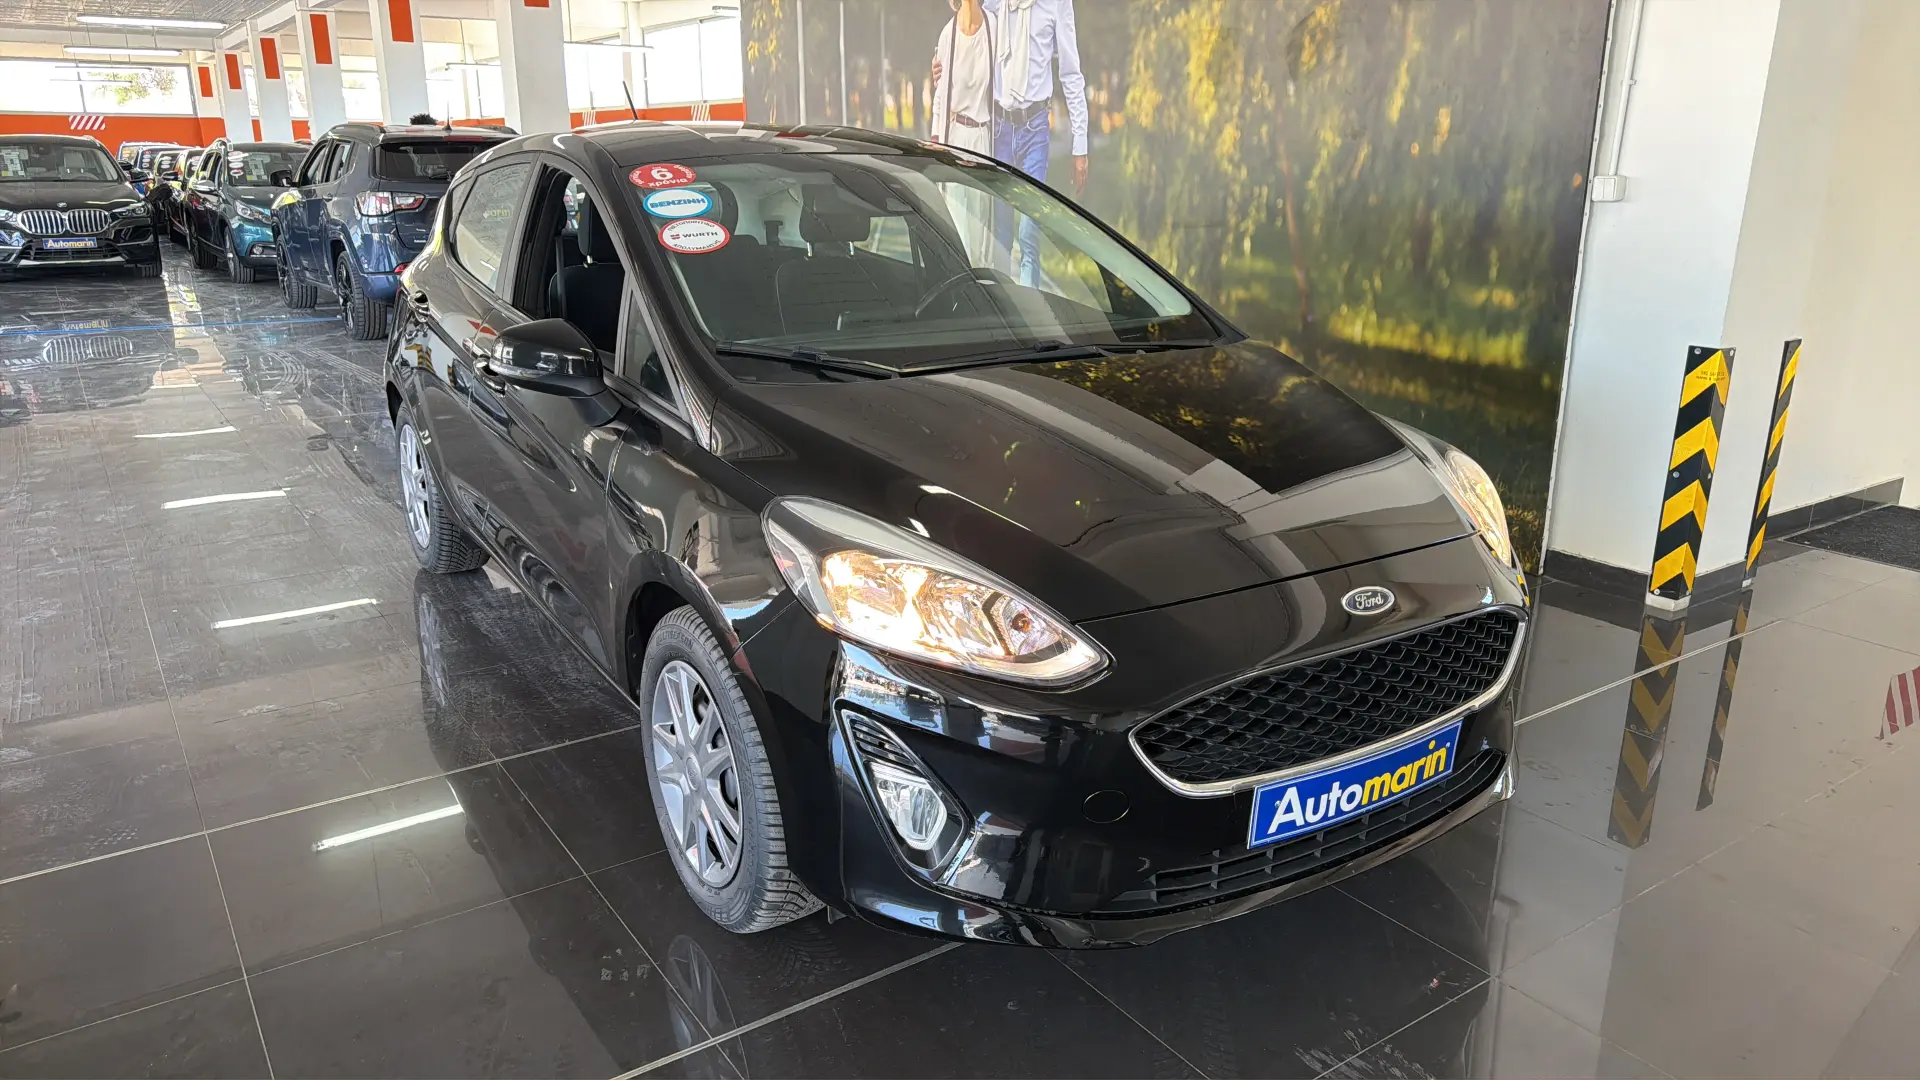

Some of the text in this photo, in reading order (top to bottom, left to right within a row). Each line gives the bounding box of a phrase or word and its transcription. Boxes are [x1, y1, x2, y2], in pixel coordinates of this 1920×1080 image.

[651, 168, 673, 180] 6
[47, 238, 94, 248] Automarin
[1355, 592, 1383, 610] Ford
[1267, 740, 1447, 834] Automarin
